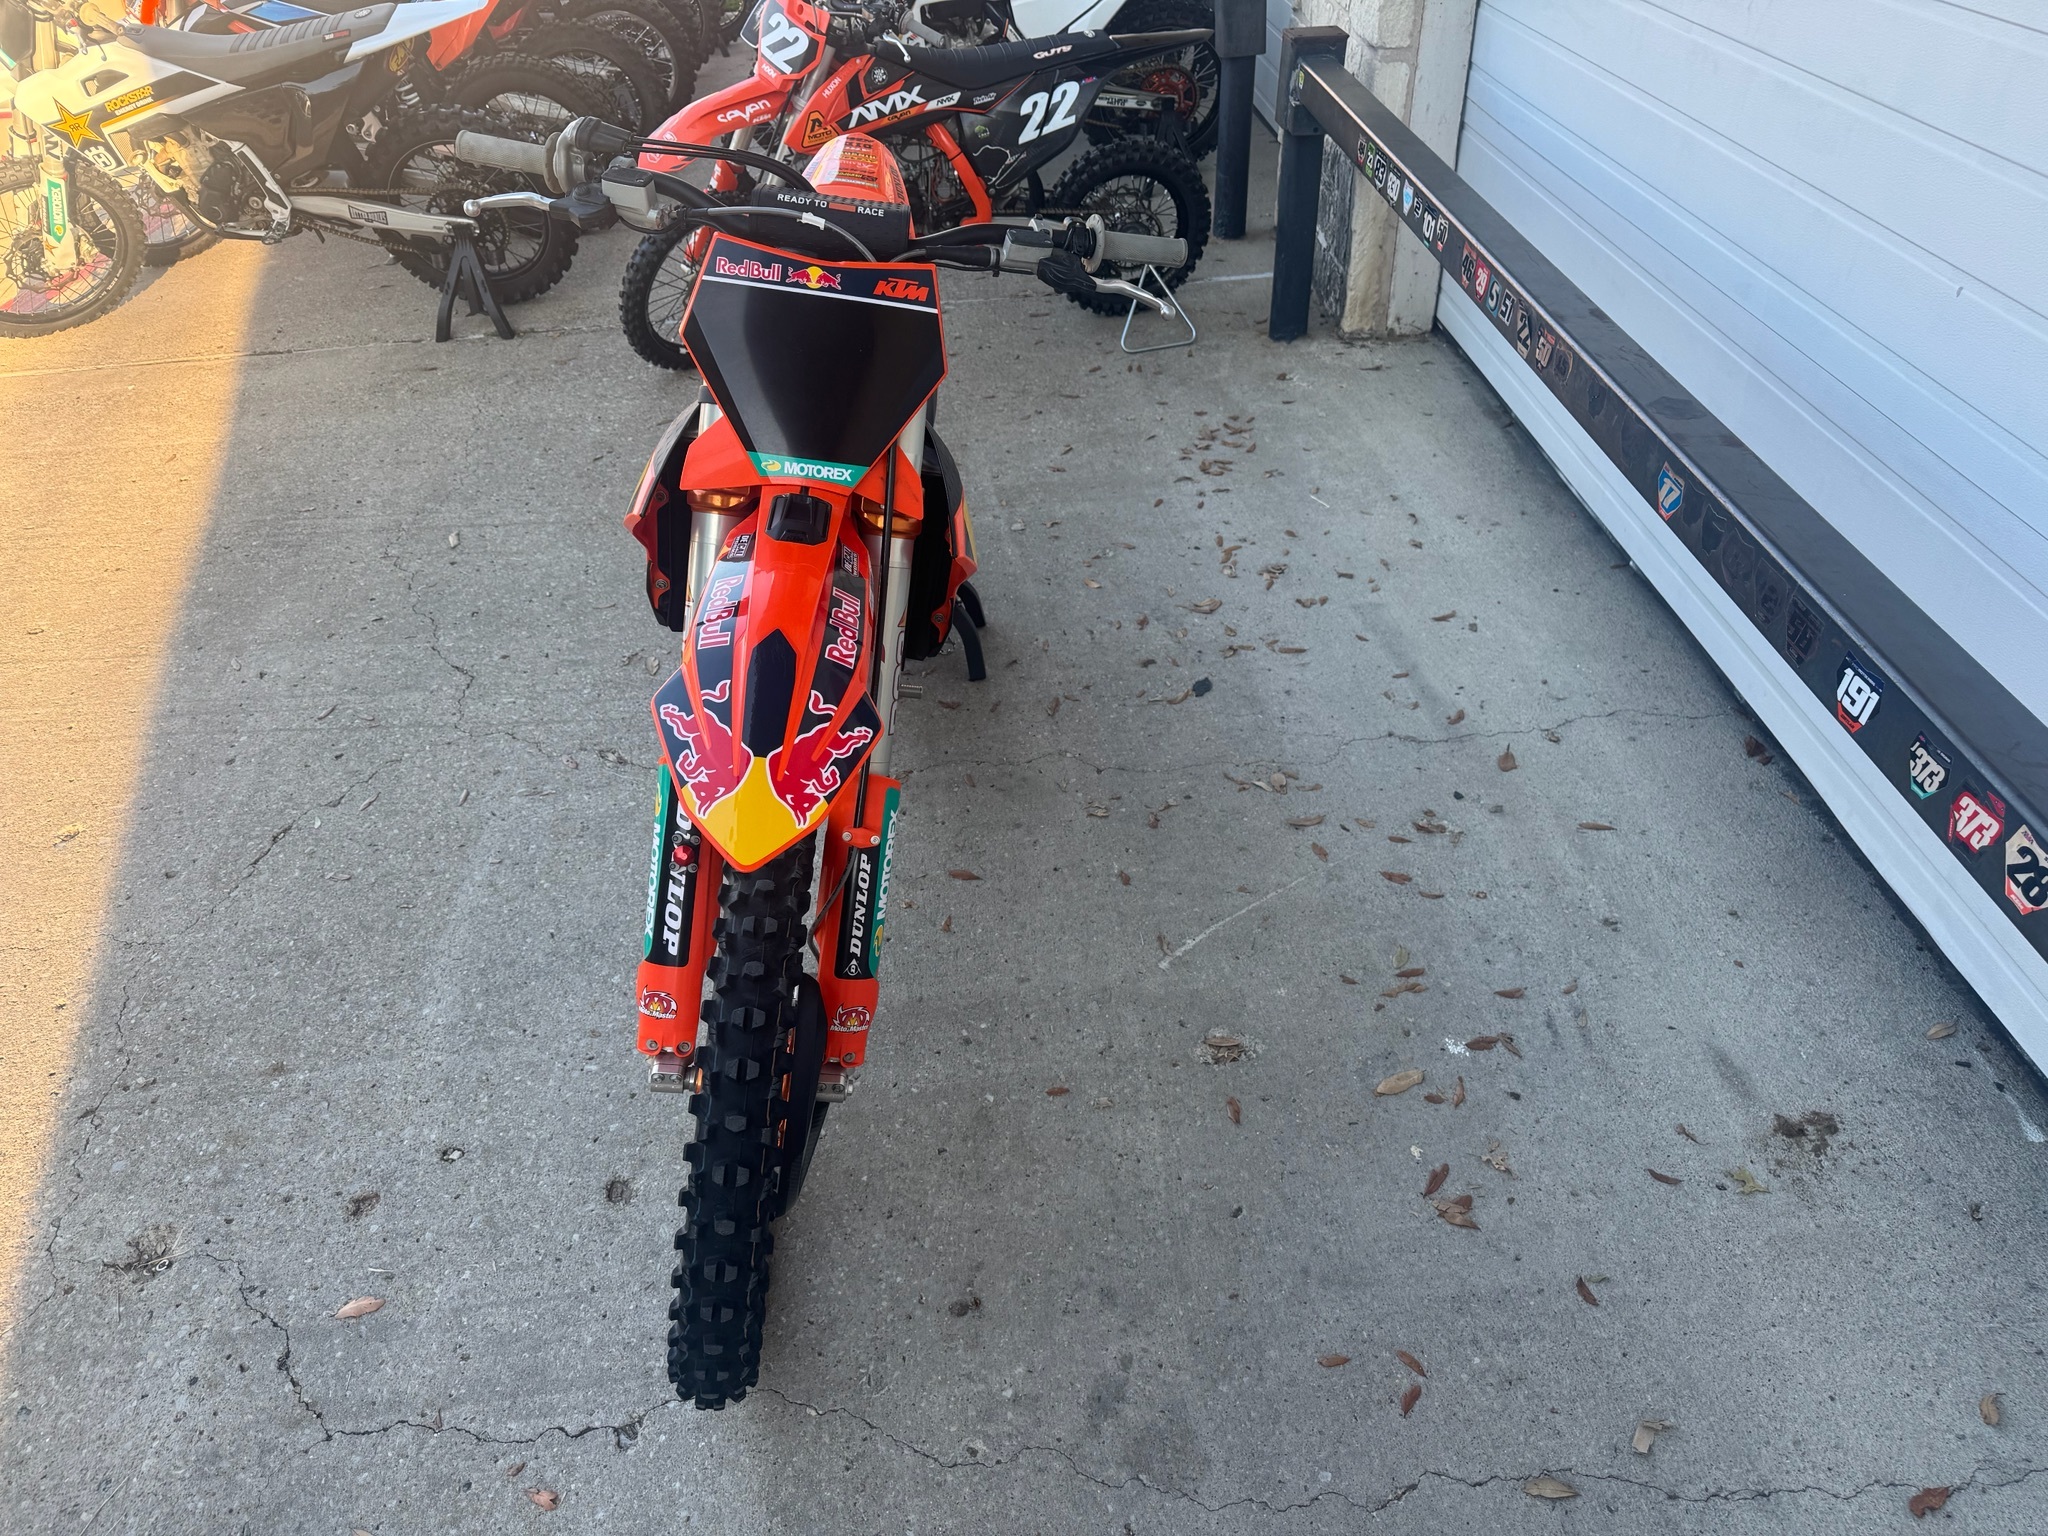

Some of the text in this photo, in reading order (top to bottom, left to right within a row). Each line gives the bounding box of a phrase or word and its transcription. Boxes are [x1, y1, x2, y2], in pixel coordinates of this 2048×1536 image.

[761, 12, 809, 75] 22
[1033, 45, 1072, 60] GUTS
[104, 86, 154, 113] ROCKSTAR
[822, 76, 842, 99] HUXON
[114, 103, 136, 116] ENERGY
[1018, 80, 1080, 145] 22
[808, 129, 832, 141] MOTO
[51, 186, 64, 225] MOTOREX
[777, 193, 885, 217] READY TO RACE
[1423, 211, 1436, 242] 101
[1462, 253, 1475, 284] 46
[1476, 267, 1488, 297] 29
[873, 277, 929, 302] KTM
[1488, 281, 1500, 312] 5
[1500, 290, 1515, 323] 51
[784, 460, 852, 482] MOTOREX
[1837, 667, 1880, 726] 191
[1954, 795, 2000, 851] 373
[876, 809, 900, 921] MOTOREX
[2006, 845, 2048, 907] 28
[644, 822, 661, 940] MOTOREX
[850, 853, 873, 957] DUNLOP
